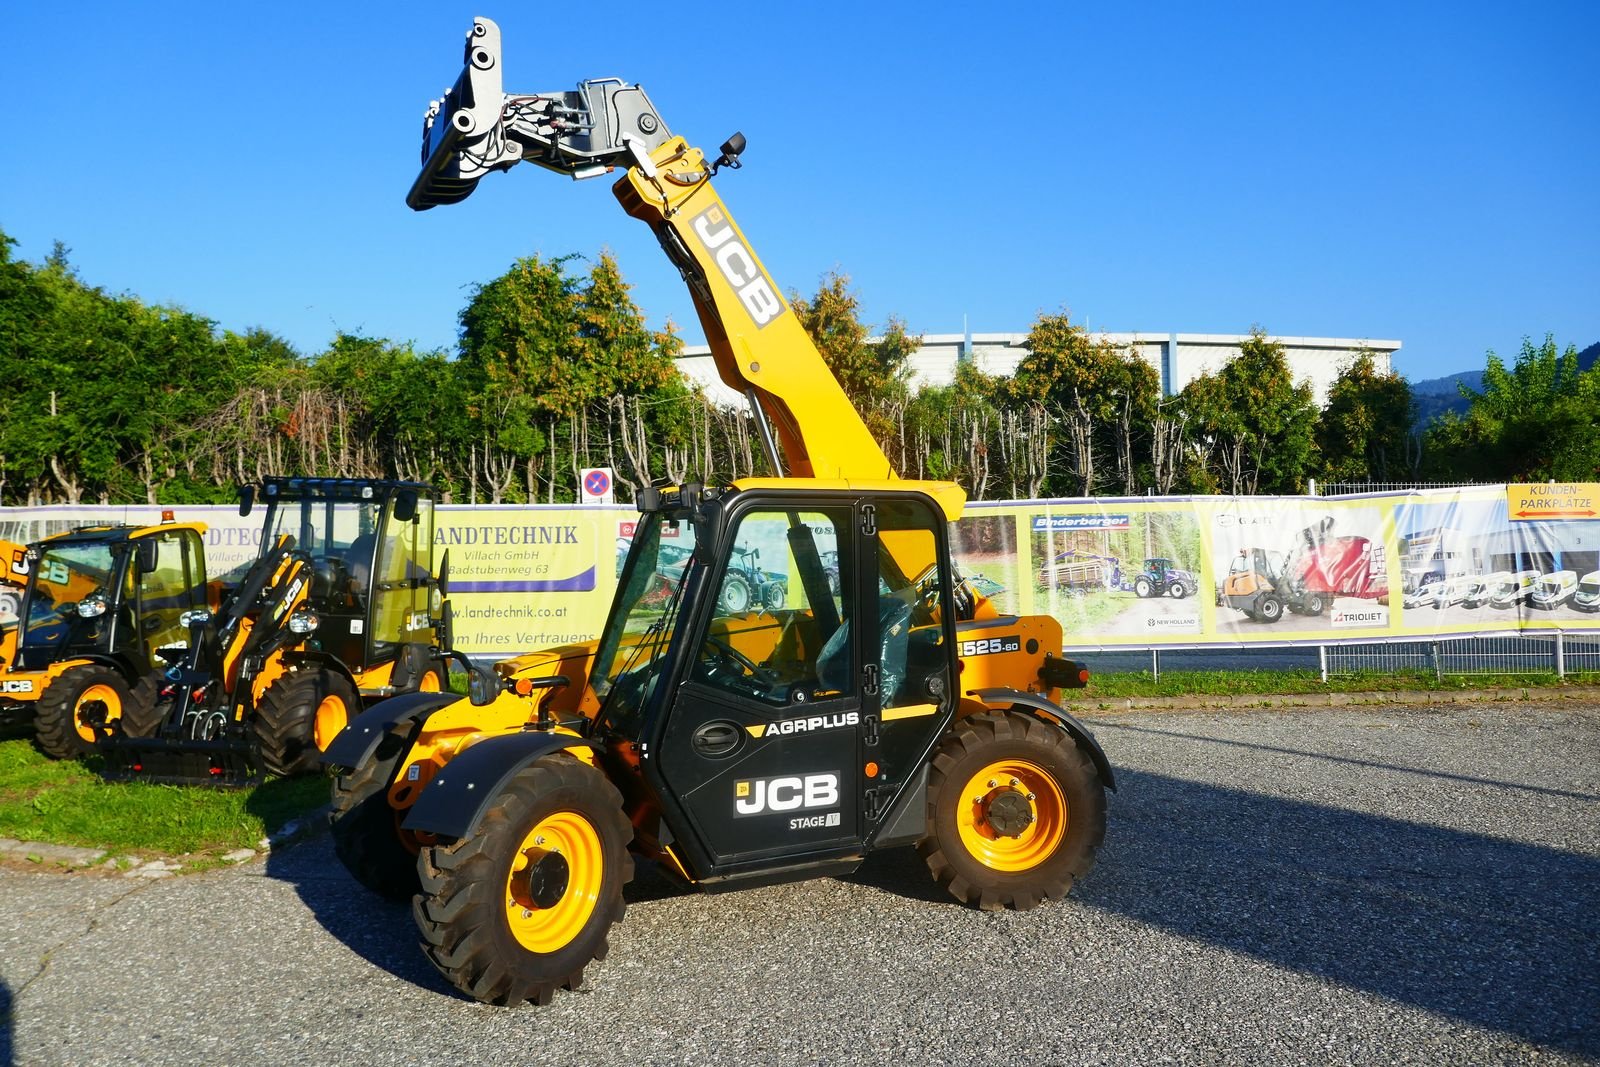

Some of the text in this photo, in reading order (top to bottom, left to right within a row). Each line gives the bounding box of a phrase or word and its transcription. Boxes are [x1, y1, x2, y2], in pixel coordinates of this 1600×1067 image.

[694, 206, 780, 324] JCB
[1530, 485, 1583, 495] KUNDEN-
[1520, 496, 1592, 508] PARKPLÄTZE
[1036, 518, 1127, 527] Binderberger
[208, 552, 243, 561] Villach
[464, 551, 540, 561] Villach GmbH
[449, 565, 549, 576] Badstubenweg 63
[283, 578, 302, 610] JCB
[452, 605, 568, 619] w.landtechnik.co.at
[1343, 613, 1382, 621] TRIOLIET
[475, 633, 511, 645] Ihres
[516, 632, 595, 645] Vertrauens
[766, 712, 859, 737] AGRIPLUS
[736, 773, 838, 814] JCB
[790, 816, 825, 829] STAGE
